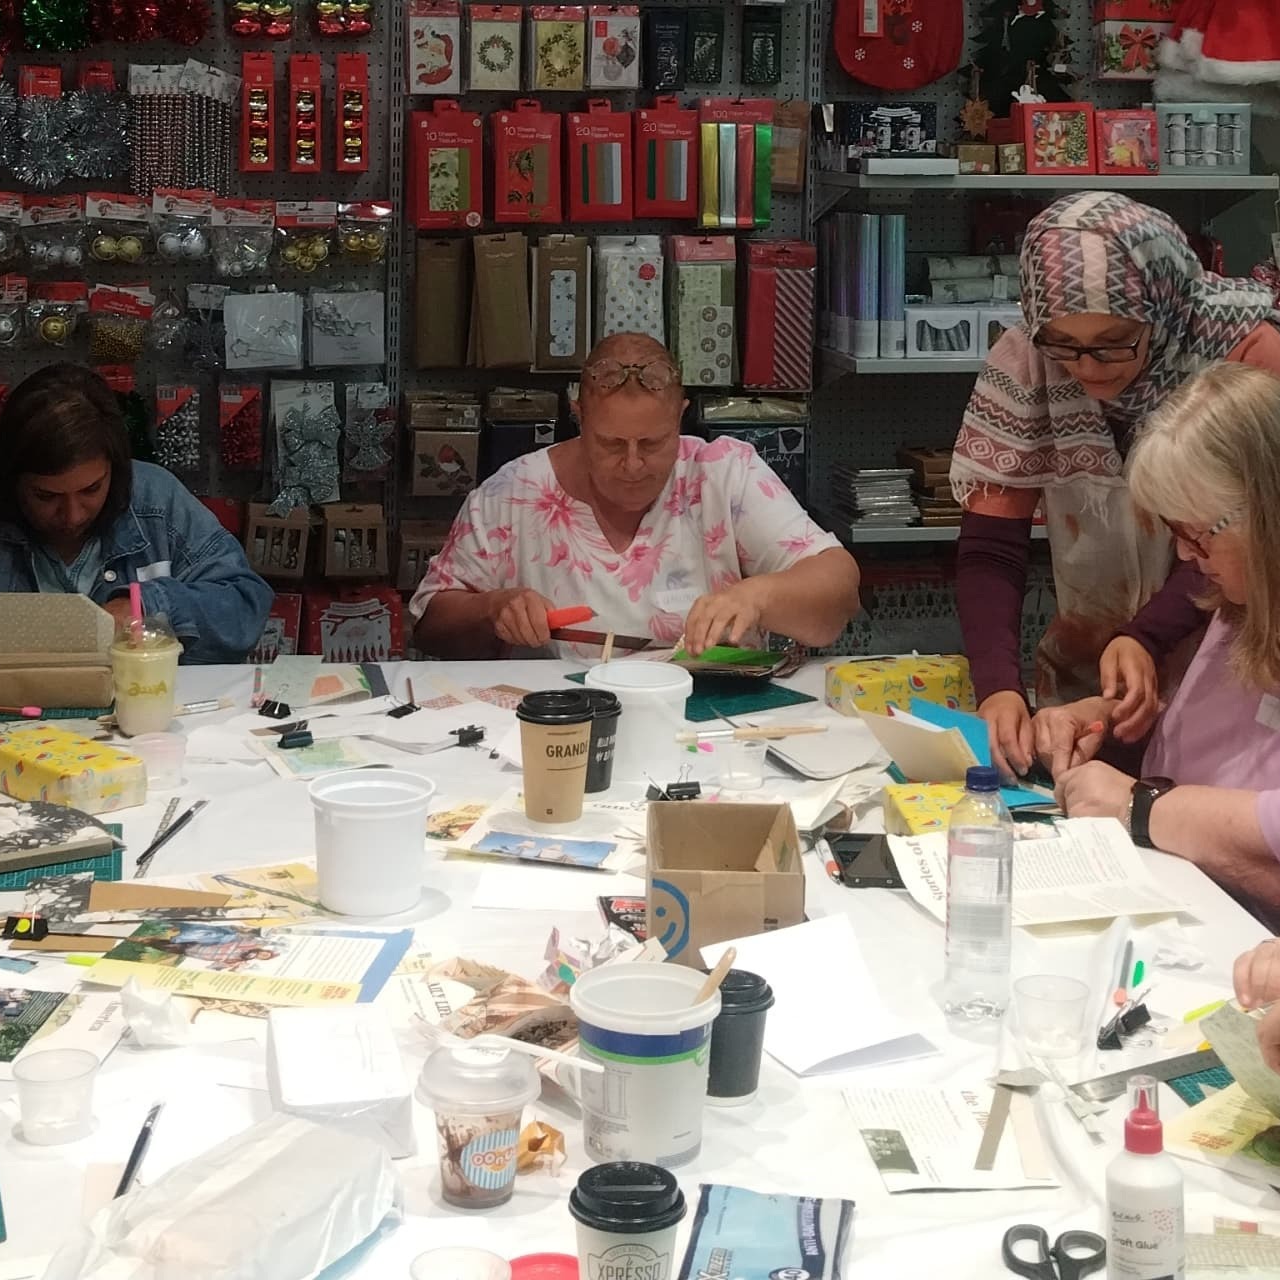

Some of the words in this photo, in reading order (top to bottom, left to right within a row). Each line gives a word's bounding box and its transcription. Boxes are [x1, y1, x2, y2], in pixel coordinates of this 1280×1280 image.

[503, 126, 515, 136] 10
[576, 126, 591, 136] 20
[642, 123, 656, 133] 20
[426, 131, 437, 141] 10
[1135, 1240, 1159, 1250] Glue
